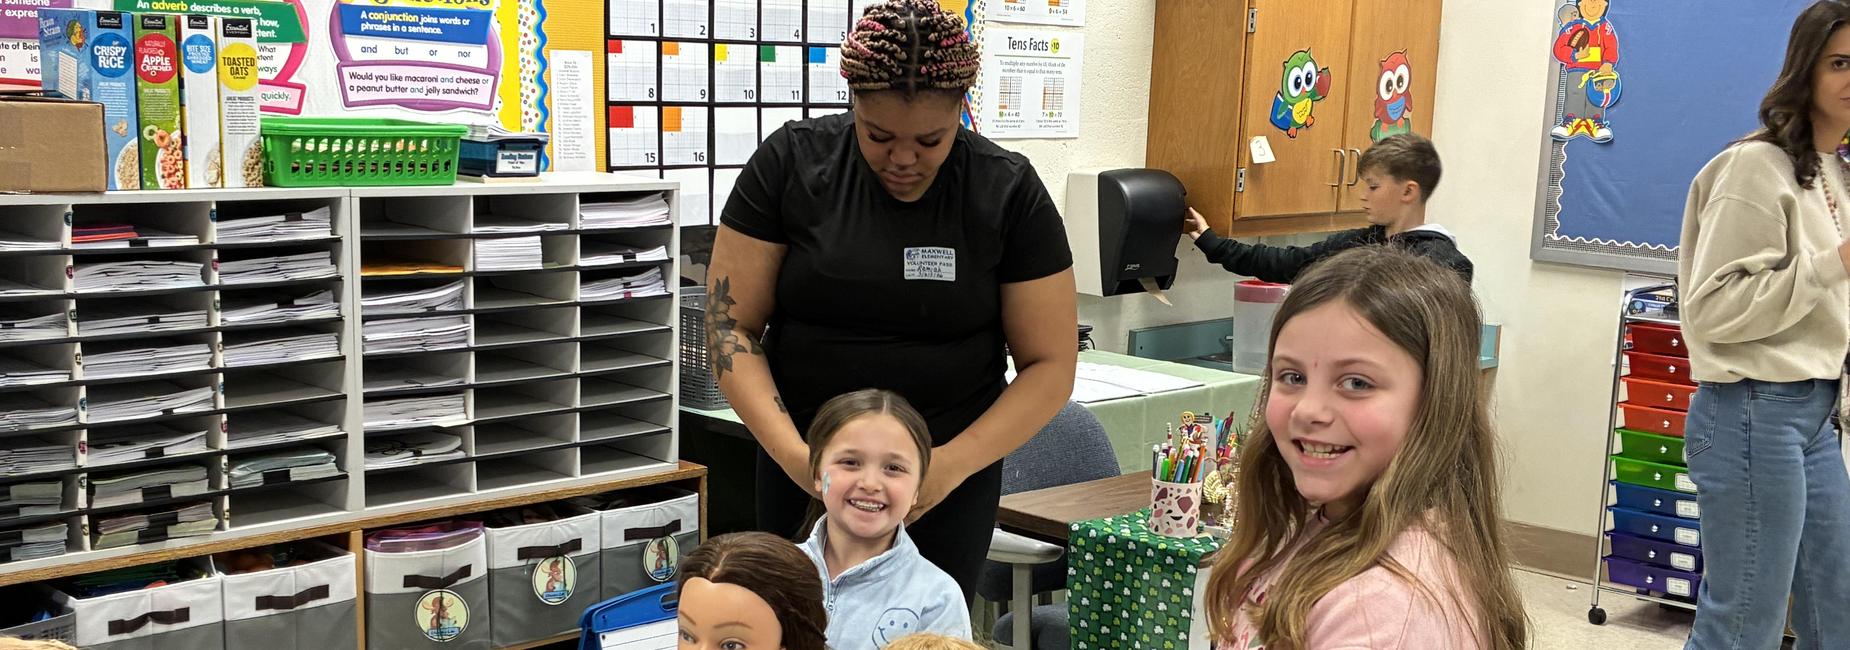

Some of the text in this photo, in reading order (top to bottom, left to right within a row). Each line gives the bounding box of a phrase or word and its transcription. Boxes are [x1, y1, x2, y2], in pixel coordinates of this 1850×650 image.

[137, 1, 149, 9] An
[152, 1, 188, 11] adverb
[190, 3, 231, 13] describes
[240, 7, 262, 16] verb,
[259, 17, 280, 28] how,
[361, 11, 367, 19] A
[369, 12, 418, 23] conjunction
[419, 14, 438, 25] joins
[439, 16, 460, 25] words
[361, 22, 391, 31] phrases
[408, 25, 443, 34] sentence.
[650, 23, 656, 34] 1
[699, 25, 706, 36] 2
[749, 28, 755, 38] 3
[793, 29, 800, 40] 4
[840, 31, 846, 41] 5
[12, 42, 20, 50] of
[1008, 36, 1027, 51] Tens
[1029, 37, 1049, 51] Facts
[94, 45, 127, 56] CRISPY
[361, 45, 377, 54] and
[395, 46, 409, 55] but
[30, 53, 38, 62] is
[98, 55, 124, 68] RICE
[142, 55, 170, 65] APPLE
[222, 57, 255, 66] TOASTED
[230, 67, 249, 75] OATS
[349, 72, 373, 80] Would
[375, 74, 388, 82] you
[405, 75, 439, 83] macaroni
[261, 91, 292, 101] quickly.
[357, 85, 383, 93] peanut
[386, 85, 408, 93] butter
[425, 87, 441, 96] jelly
[442, 87, 478, 95] sandwich?
[648, 88, 655, 99] 8
[700, 89, 706, 99] 9
[743, 89, 754, 100] 10
[791, 90, 800, 100] 11
[836, 90, 847, 101] 12
[645, 153, 656, 163] 15
[693, 152, 705, 162] 16
